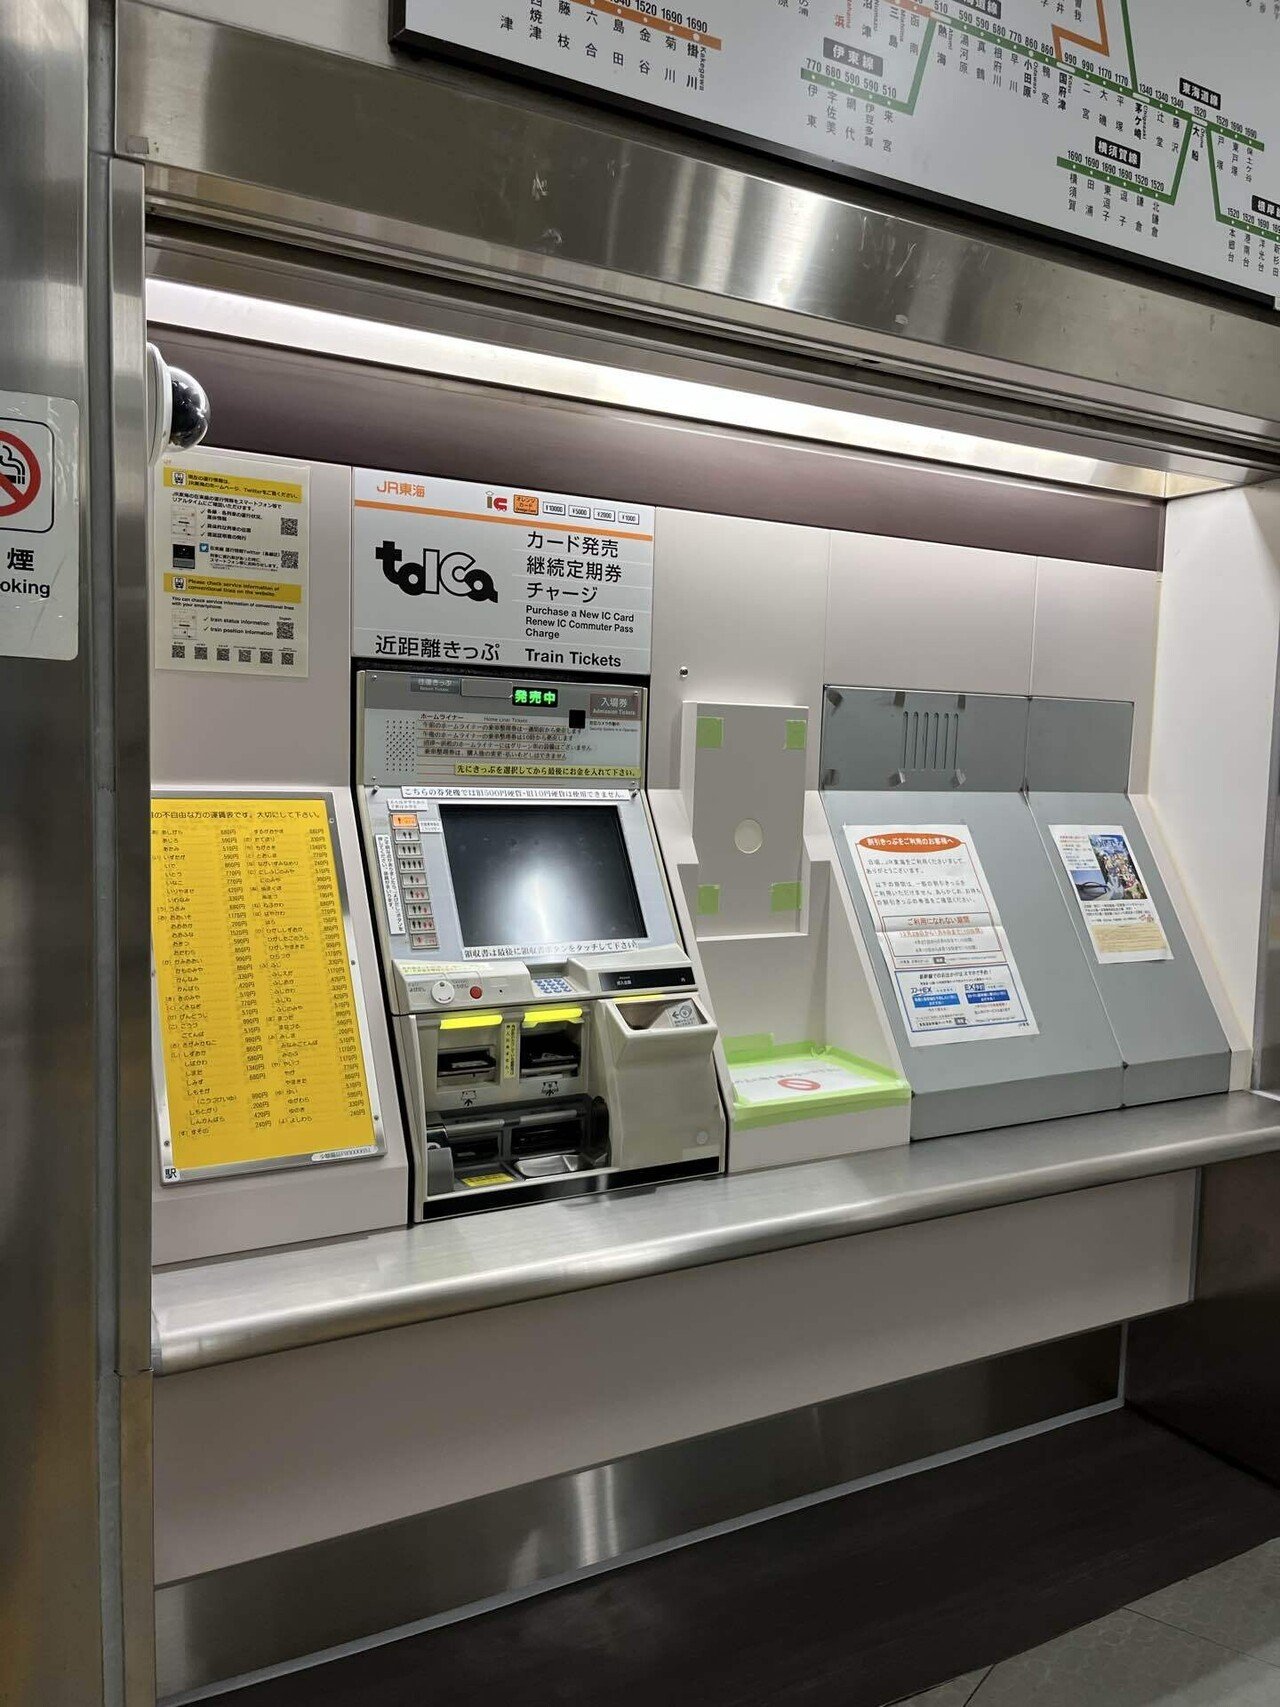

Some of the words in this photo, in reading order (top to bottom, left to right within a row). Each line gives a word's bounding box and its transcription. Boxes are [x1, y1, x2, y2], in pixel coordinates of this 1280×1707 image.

[635, 0, 657, 16] 1520
[661, 7, 682, 24] 1690
[686, 16, 707, 33] 1690
[585, 10, 598, 58] 六合
[613, 19, 625, 66] 島田
[639, 28, 652, 75] 金谷
[665, 35, 677, 83] 菊川
[832, 44, 874, 71] 伊東線
[958, 10, 973, 24] 590
[975, 16, 990, 31] 590
[1009, 30, 1022, 43] 770
[1064, 52, 1077, 65] 990
[1081, 59, 1094, 73] 990
[1098, 66, 1112, 80] 1170
[1114, 73, 1129, 87] 1170
[1139, 83, 1153, 97] 1340
[1155, 90, 1169, 103] 1340
[1170, 96, 1184, 109] 1340
[687, 42, 699, 90] 掛川
[699, 47, 707, 91] Kakegawa
[806, 58, 822, 73] 770
[825, 65, 841, 80] 680
[844, 72, 860, 87] 590
[863, 78, 879, 93] 590
[882, 85, 897, 99] 510
[1023, 59, 1033, 98] 小田原
[1057, 72, 1068, 111] 国府津
[807, 85, 818, 129] 伊東
[1193, 105, 1207, 119] 1520
[1097, 141, 1139, 165] 横須賀線
[1067, 150, 1082, 163] 1690
[1085, 156, 1099, 169] 1690
[1101, 162, 1116, 175] 1690
[1118, 168, 1133, 180] 1690
[1134, 173, 1149, 186] 1520
[1150, 179, 1165, 192] 1520
[377, 480, 425, 498] JR東海
[527, 531, 618, 558] カード発売
[527, 555, 622, 583] 継続定期券
[527, 582, 598, 603] チャージ
[525, 616, 555, 627] Renew
[557, 619, 566, 628] IC
[569, 620, 612, 632] Commuter
[614, 624, 634, 633] Pass
[526, 604, 569, 617] Purchase
[580, 609, 599, 619] New
[601, 611, 611, 620] IC
[613, 612, 634, 622] Card
[375, 634, 500, 661] 近距離きっぷ
[525, 628, 560, 640] Charge
[525, 648, 564, 663] Train
[569, 651, 621, 667] Tickets
[514, 689, 556, 704] 発売中
[601, 697, 628, 707] 入場券
